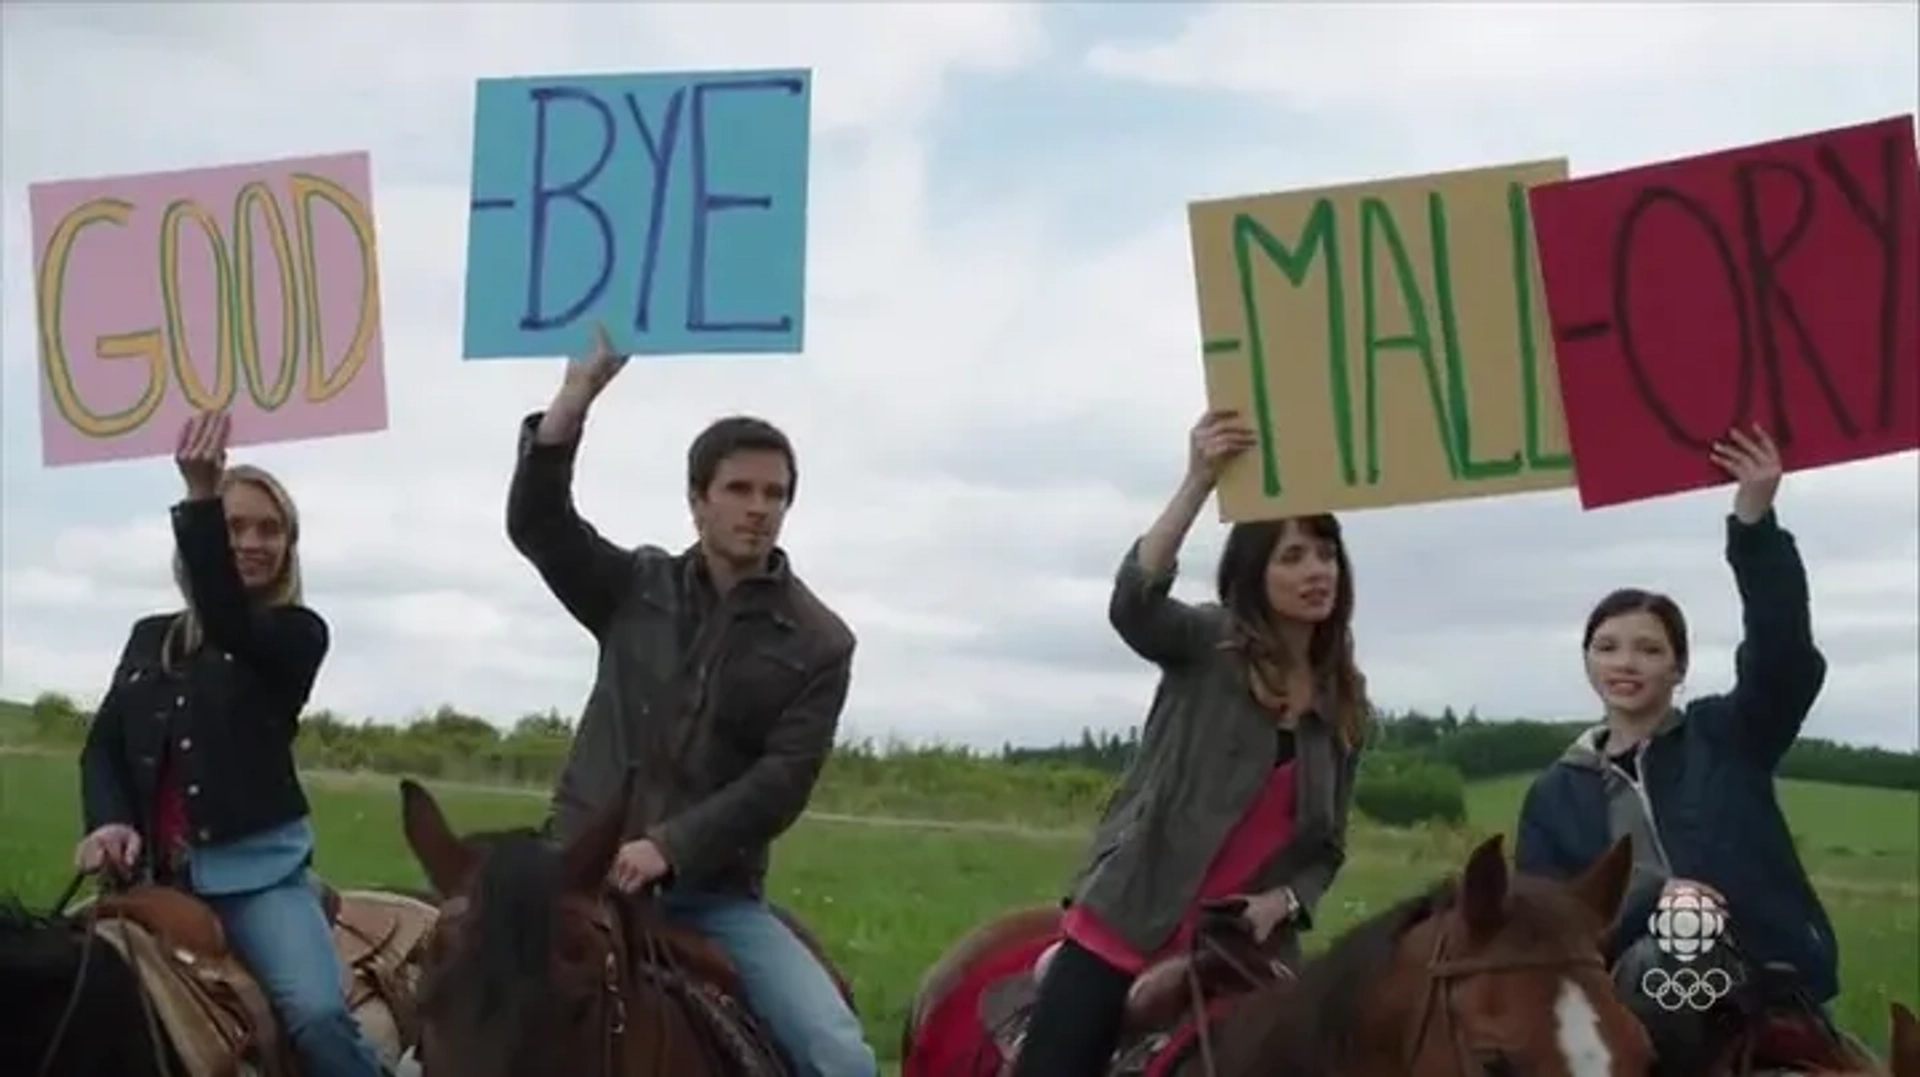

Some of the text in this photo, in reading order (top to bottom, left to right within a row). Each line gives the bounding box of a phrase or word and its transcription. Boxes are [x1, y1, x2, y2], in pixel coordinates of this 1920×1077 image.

[38, 173, 380, 438] GOOD
[471, 79, 803, 332] -BYE
[1204, 182, 1573, 497] -MALL
[1561, 136, 1902, 453] -ORY
